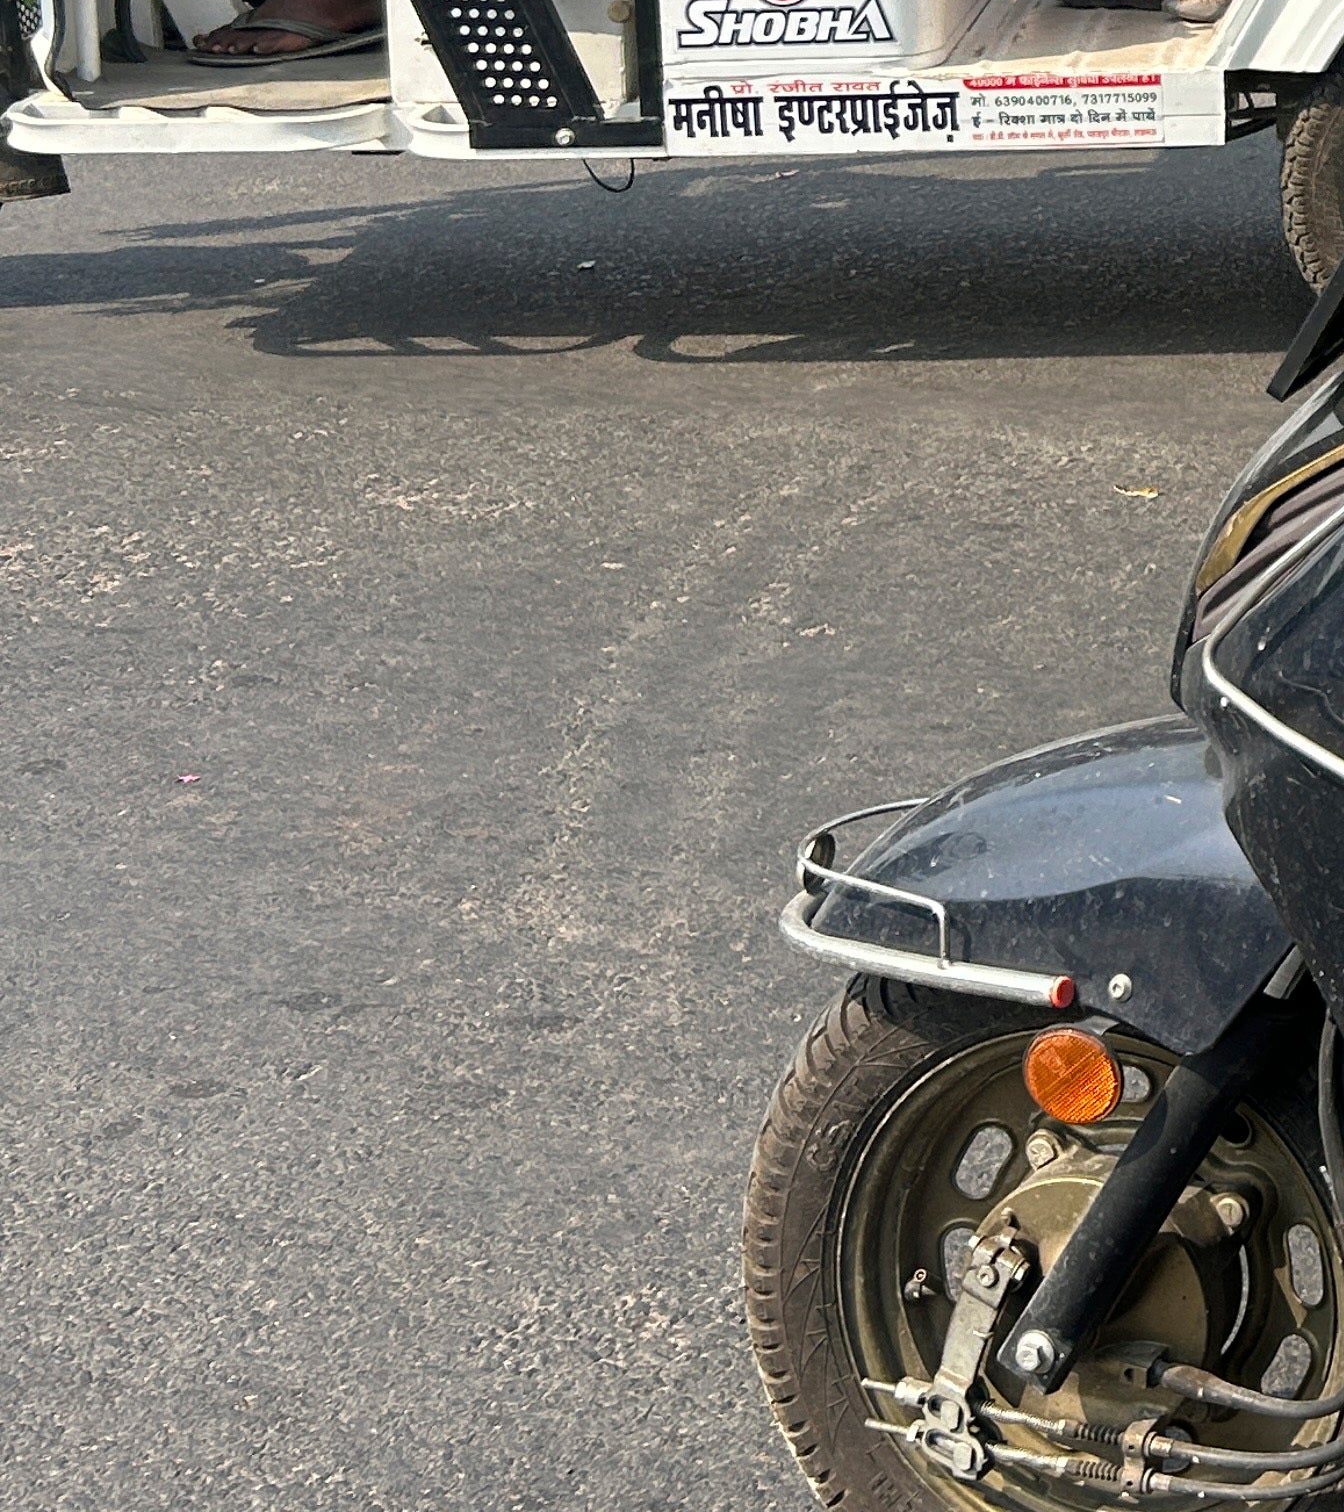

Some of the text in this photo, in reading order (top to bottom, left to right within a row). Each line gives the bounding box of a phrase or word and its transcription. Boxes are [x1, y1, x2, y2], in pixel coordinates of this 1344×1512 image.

[769, 79, 823, 93] रंजीत
[830, 80, 882, 92] रावत
[995, 94, 1078, 108] 6390400716,
[1082, 92, 1158, 106] 7317715099
[669, 85, 764, 138] मनीषा
